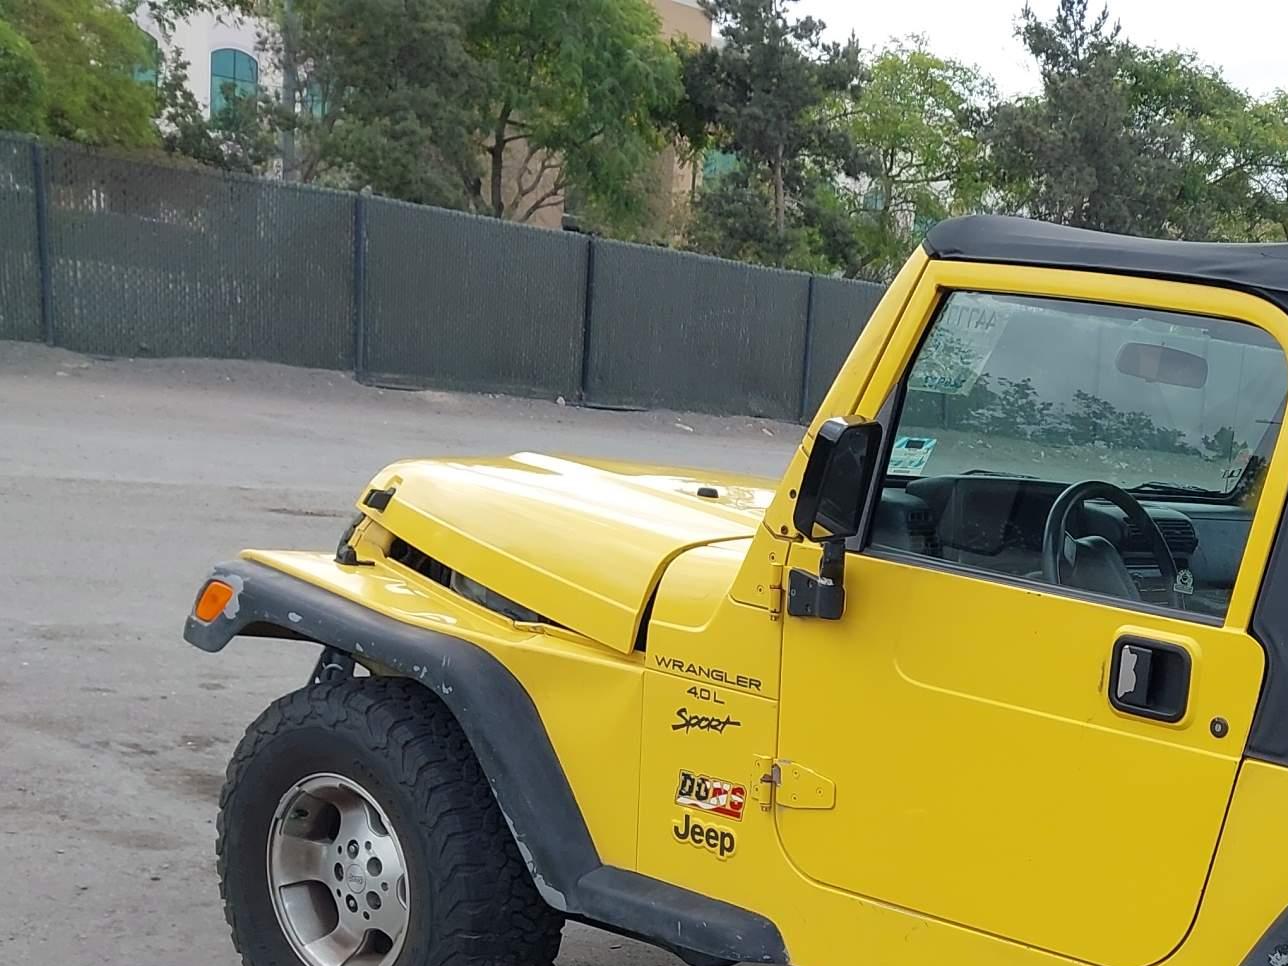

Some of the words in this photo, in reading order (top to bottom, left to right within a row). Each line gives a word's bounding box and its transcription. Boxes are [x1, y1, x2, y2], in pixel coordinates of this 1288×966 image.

[655, 655, 762, 692] WRANGLER
[672, 707, 741, 734] Sport
[674, 814, 735, 857] Jeep
